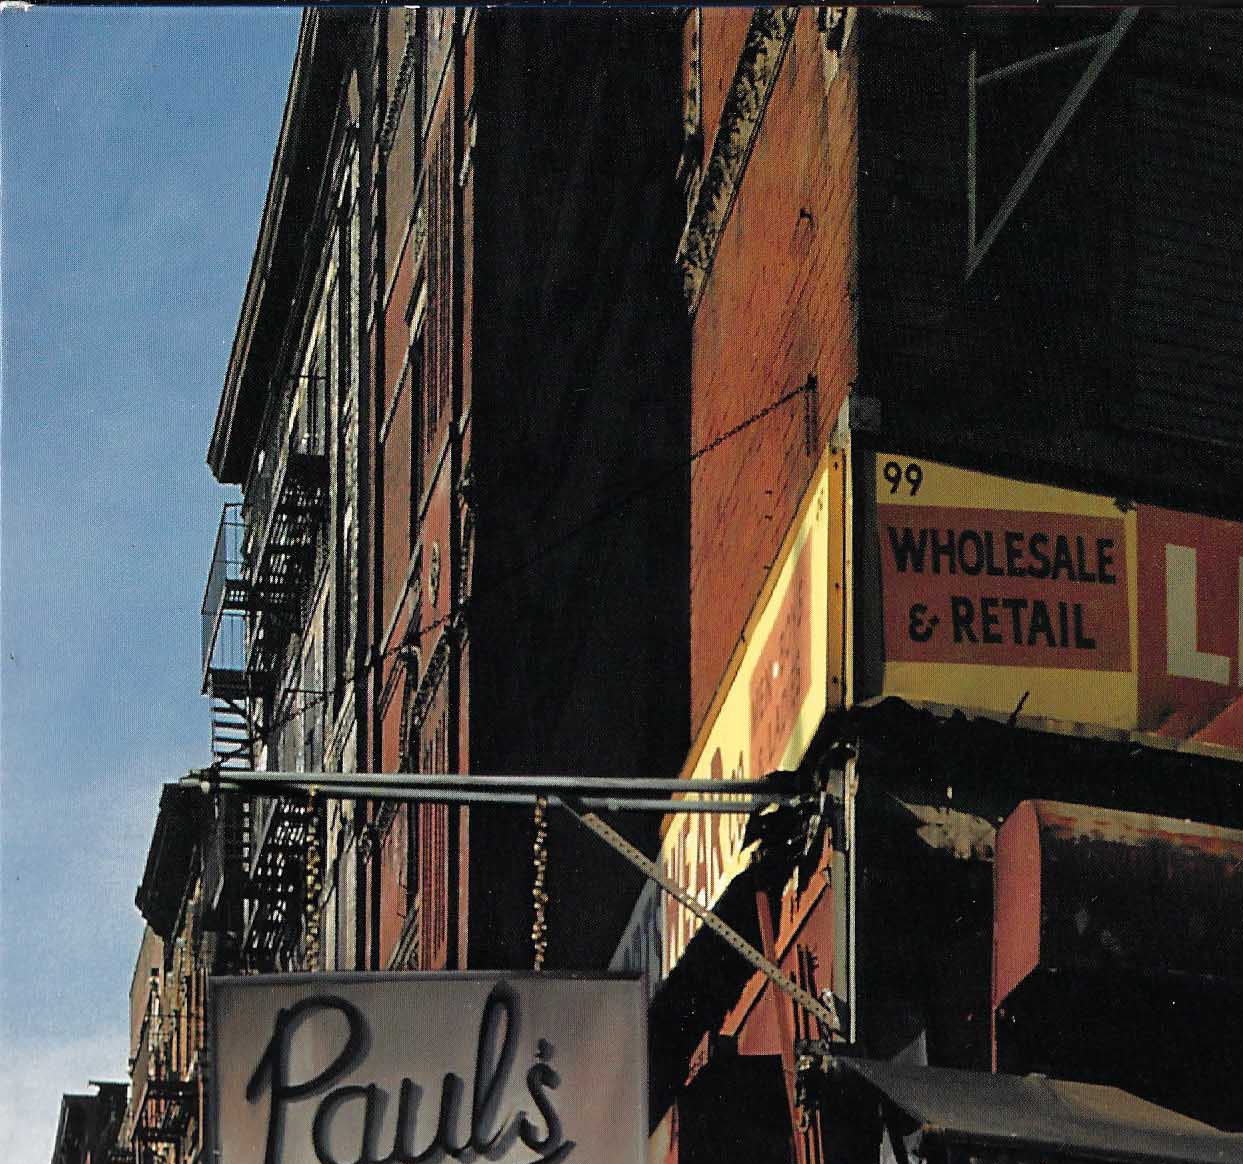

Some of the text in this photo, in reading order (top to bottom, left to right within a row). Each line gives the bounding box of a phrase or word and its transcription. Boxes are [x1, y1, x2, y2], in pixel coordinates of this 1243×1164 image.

[882, 461, 924, 498] 99
[887, 525, 1117, 585] WHOLESALE
[908, 598, 1097, 650] & RETAIL
